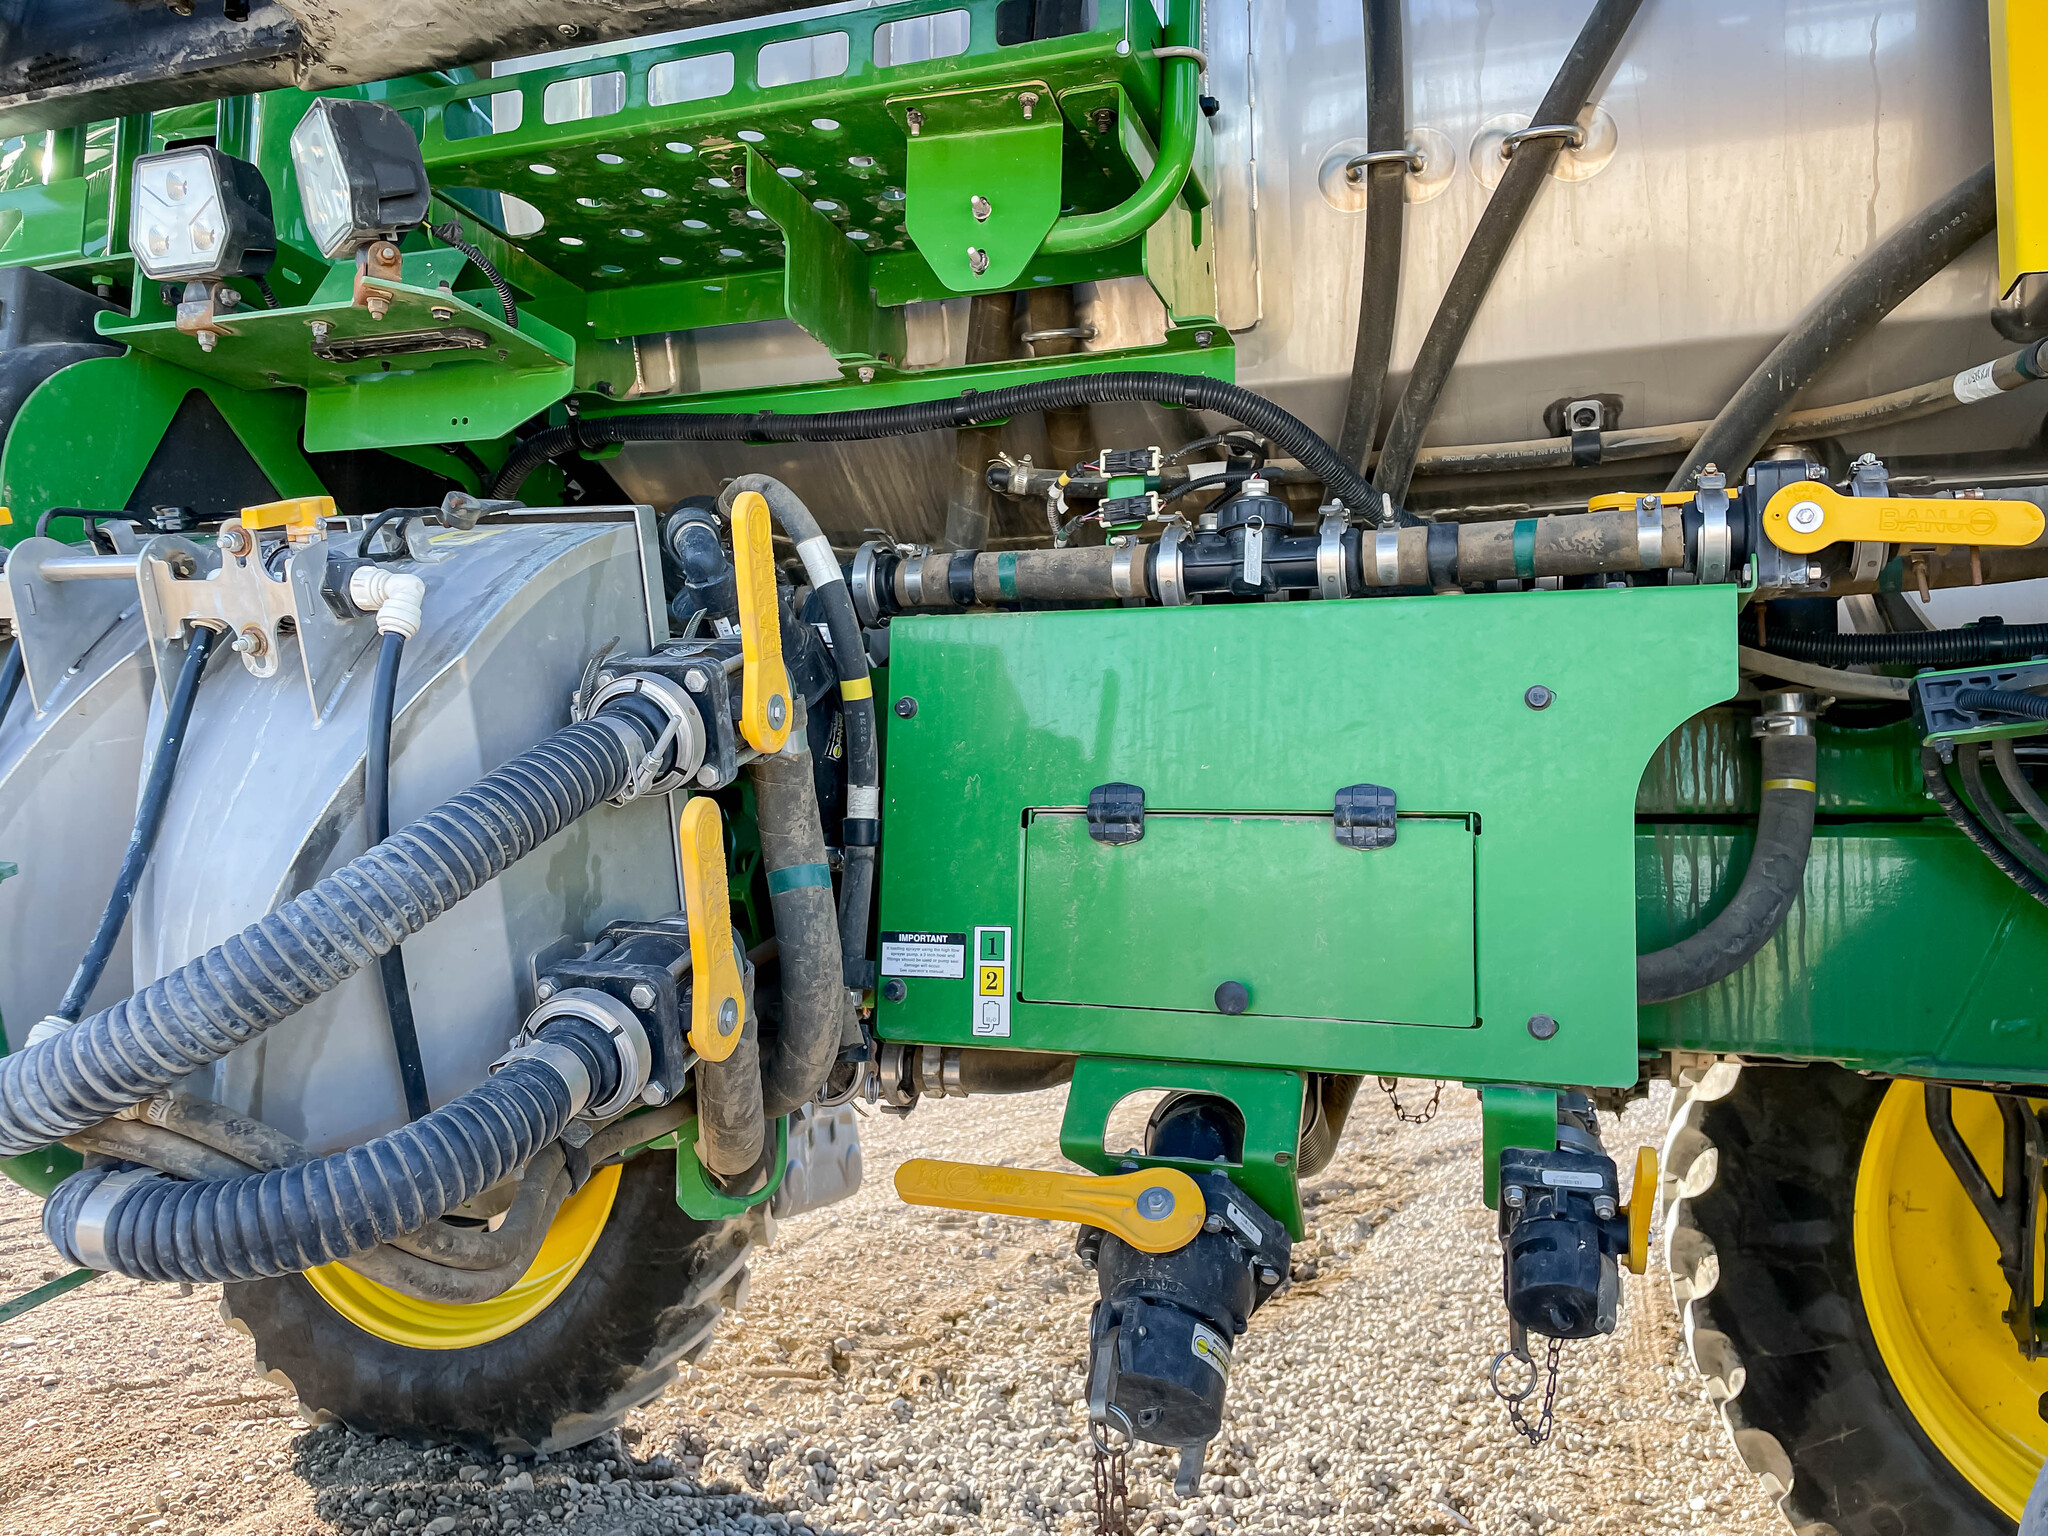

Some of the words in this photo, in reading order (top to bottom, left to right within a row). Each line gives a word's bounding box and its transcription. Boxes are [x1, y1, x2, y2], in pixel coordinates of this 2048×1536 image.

[1879, 507, 1998, 536] BANJO
[899, 934, 948, 943] IMPORTANT
[988, 936, 997, 956] 1
[986, 971, 998, 990] 2
